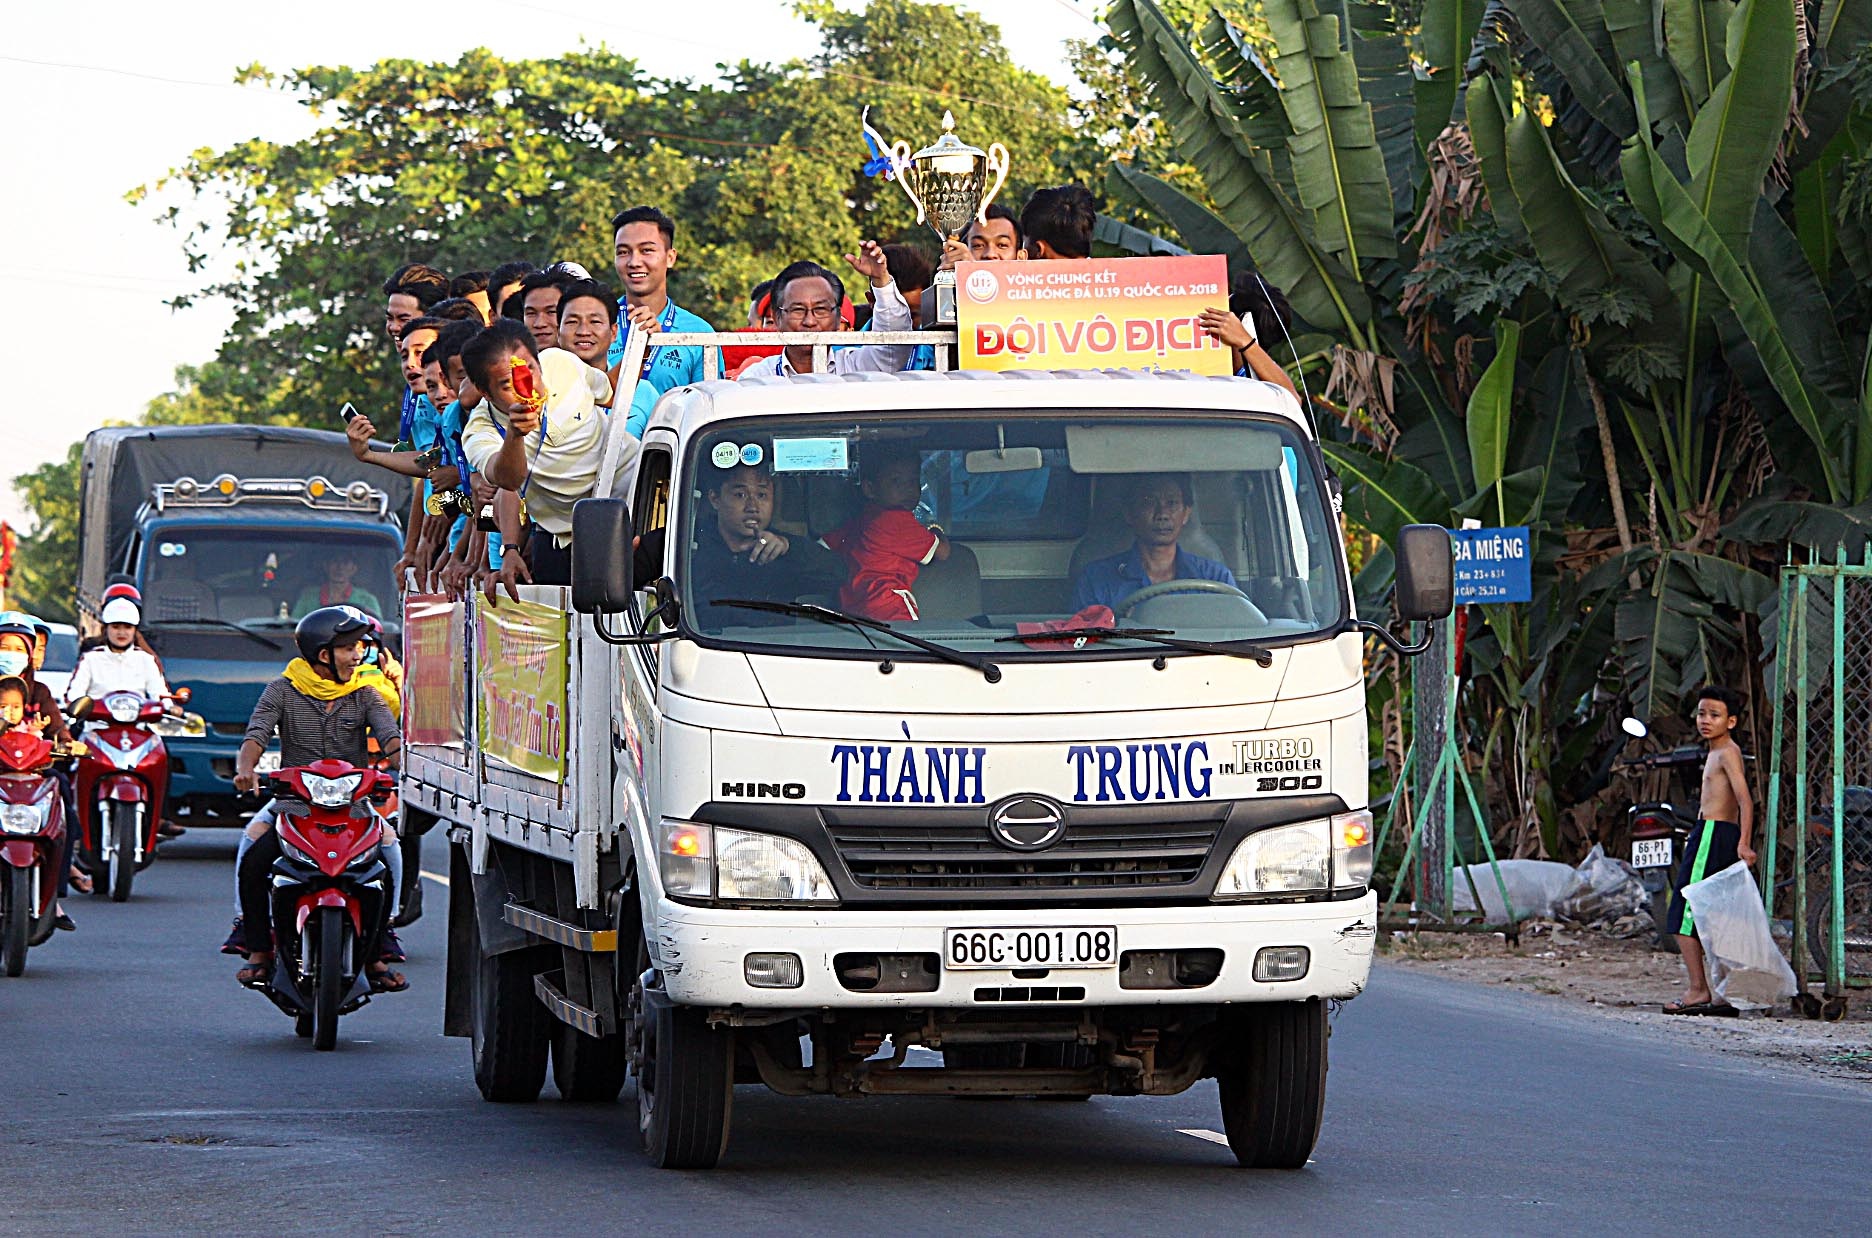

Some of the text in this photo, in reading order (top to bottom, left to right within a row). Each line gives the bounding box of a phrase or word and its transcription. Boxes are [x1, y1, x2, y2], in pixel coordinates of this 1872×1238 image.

[1006, 268, 1117, 286] VÒNG CHUNG KẾT
[1007, 282, 1218, 300] GIẢI BÓNG ĐÁ U.19 QUỐC GIA 2018
[976, 315, 1221, 361] ĐỘI VÔ ĐỊCH
[1455, 535, 1523, 561] BA MIỆNG
[831, 718, 986, 803] THÀNH
[1219, 759, 1322, 775] INTERCOOLER
[1232, 738, 1313, 774] TURBO
[1067, 741, 1212, 801] TRUNG
[721, 782, 806, 799] HINO
[1638, 842, 1664, 853] 66-P1
[952, 931, 1110, 962] 66C-001.08
